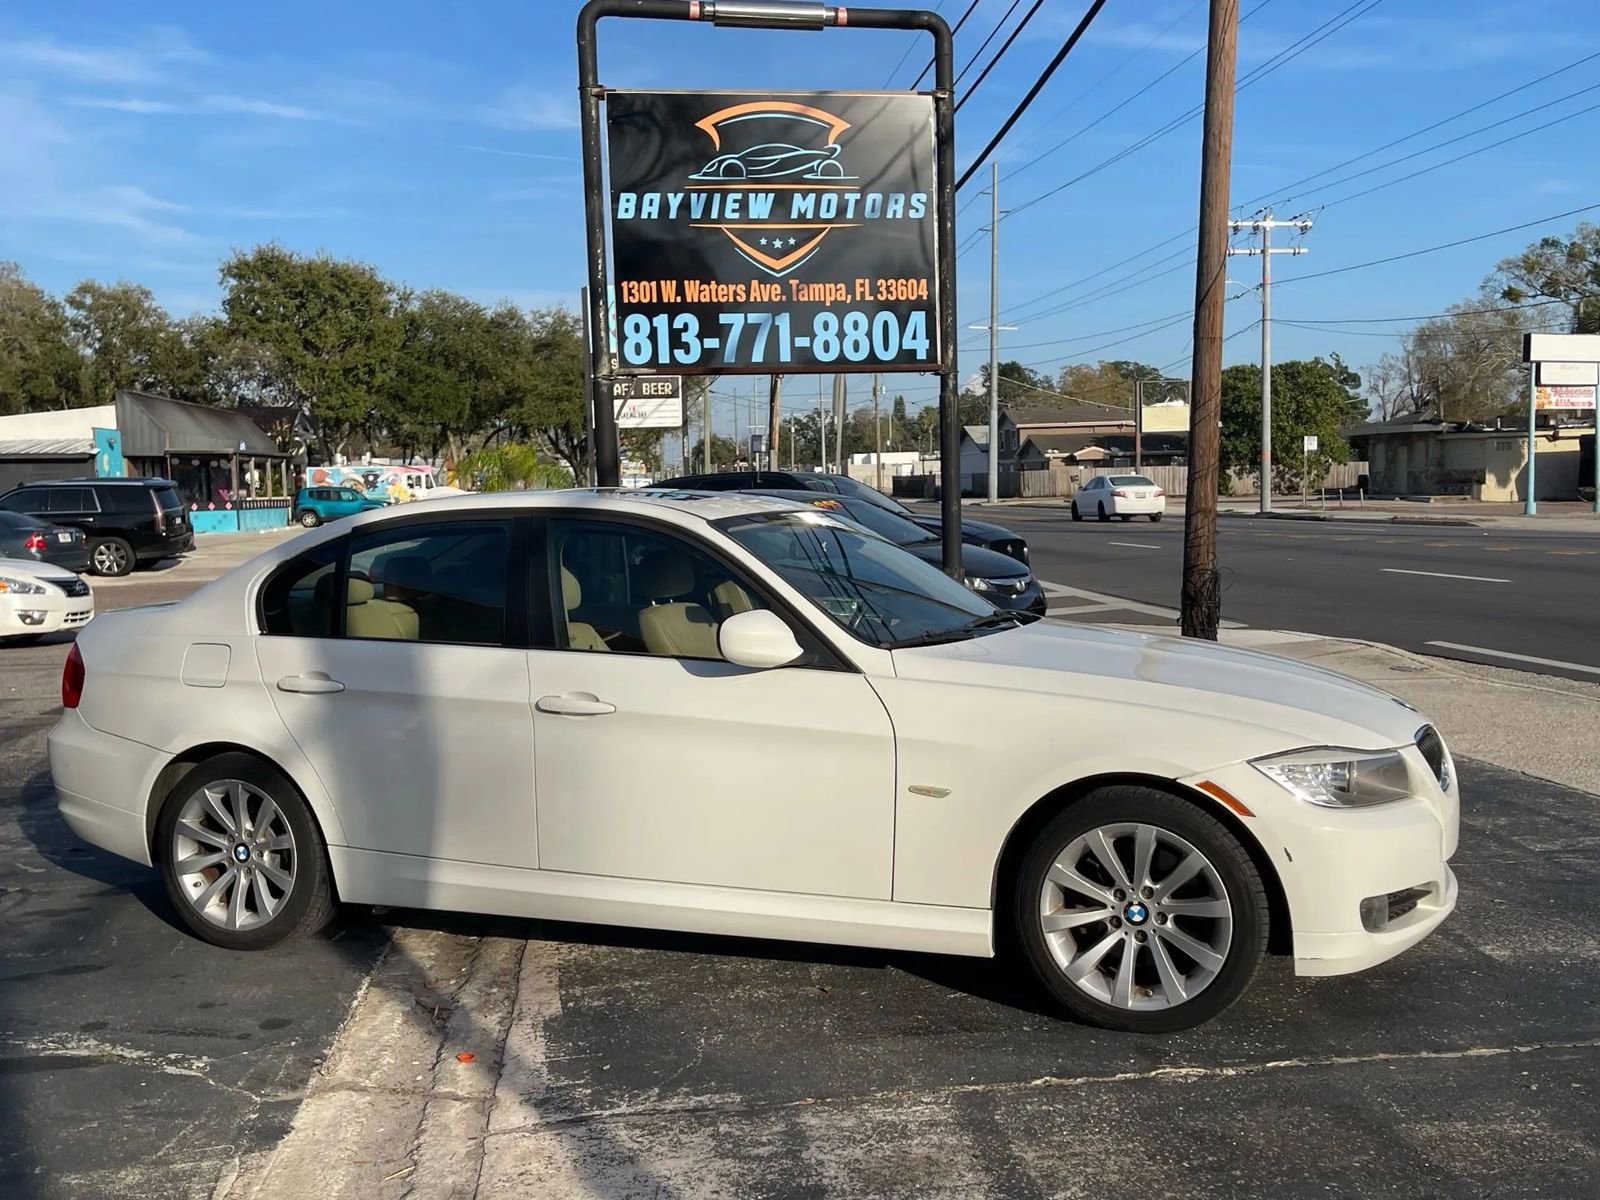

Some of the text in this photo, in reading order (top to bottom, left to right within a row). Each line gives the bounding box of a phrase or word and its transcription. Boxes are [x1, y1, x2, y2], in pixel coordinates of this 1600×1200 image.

[617, 191, 928, 220] BAYVIEW MOTORS
[620, 278, 929, 307] 1301 W. Waters Ave. Tampa, FL 33604
[622, 311, 930, 365] 813-771-8804
[642, 382, 673, 395] BEER
